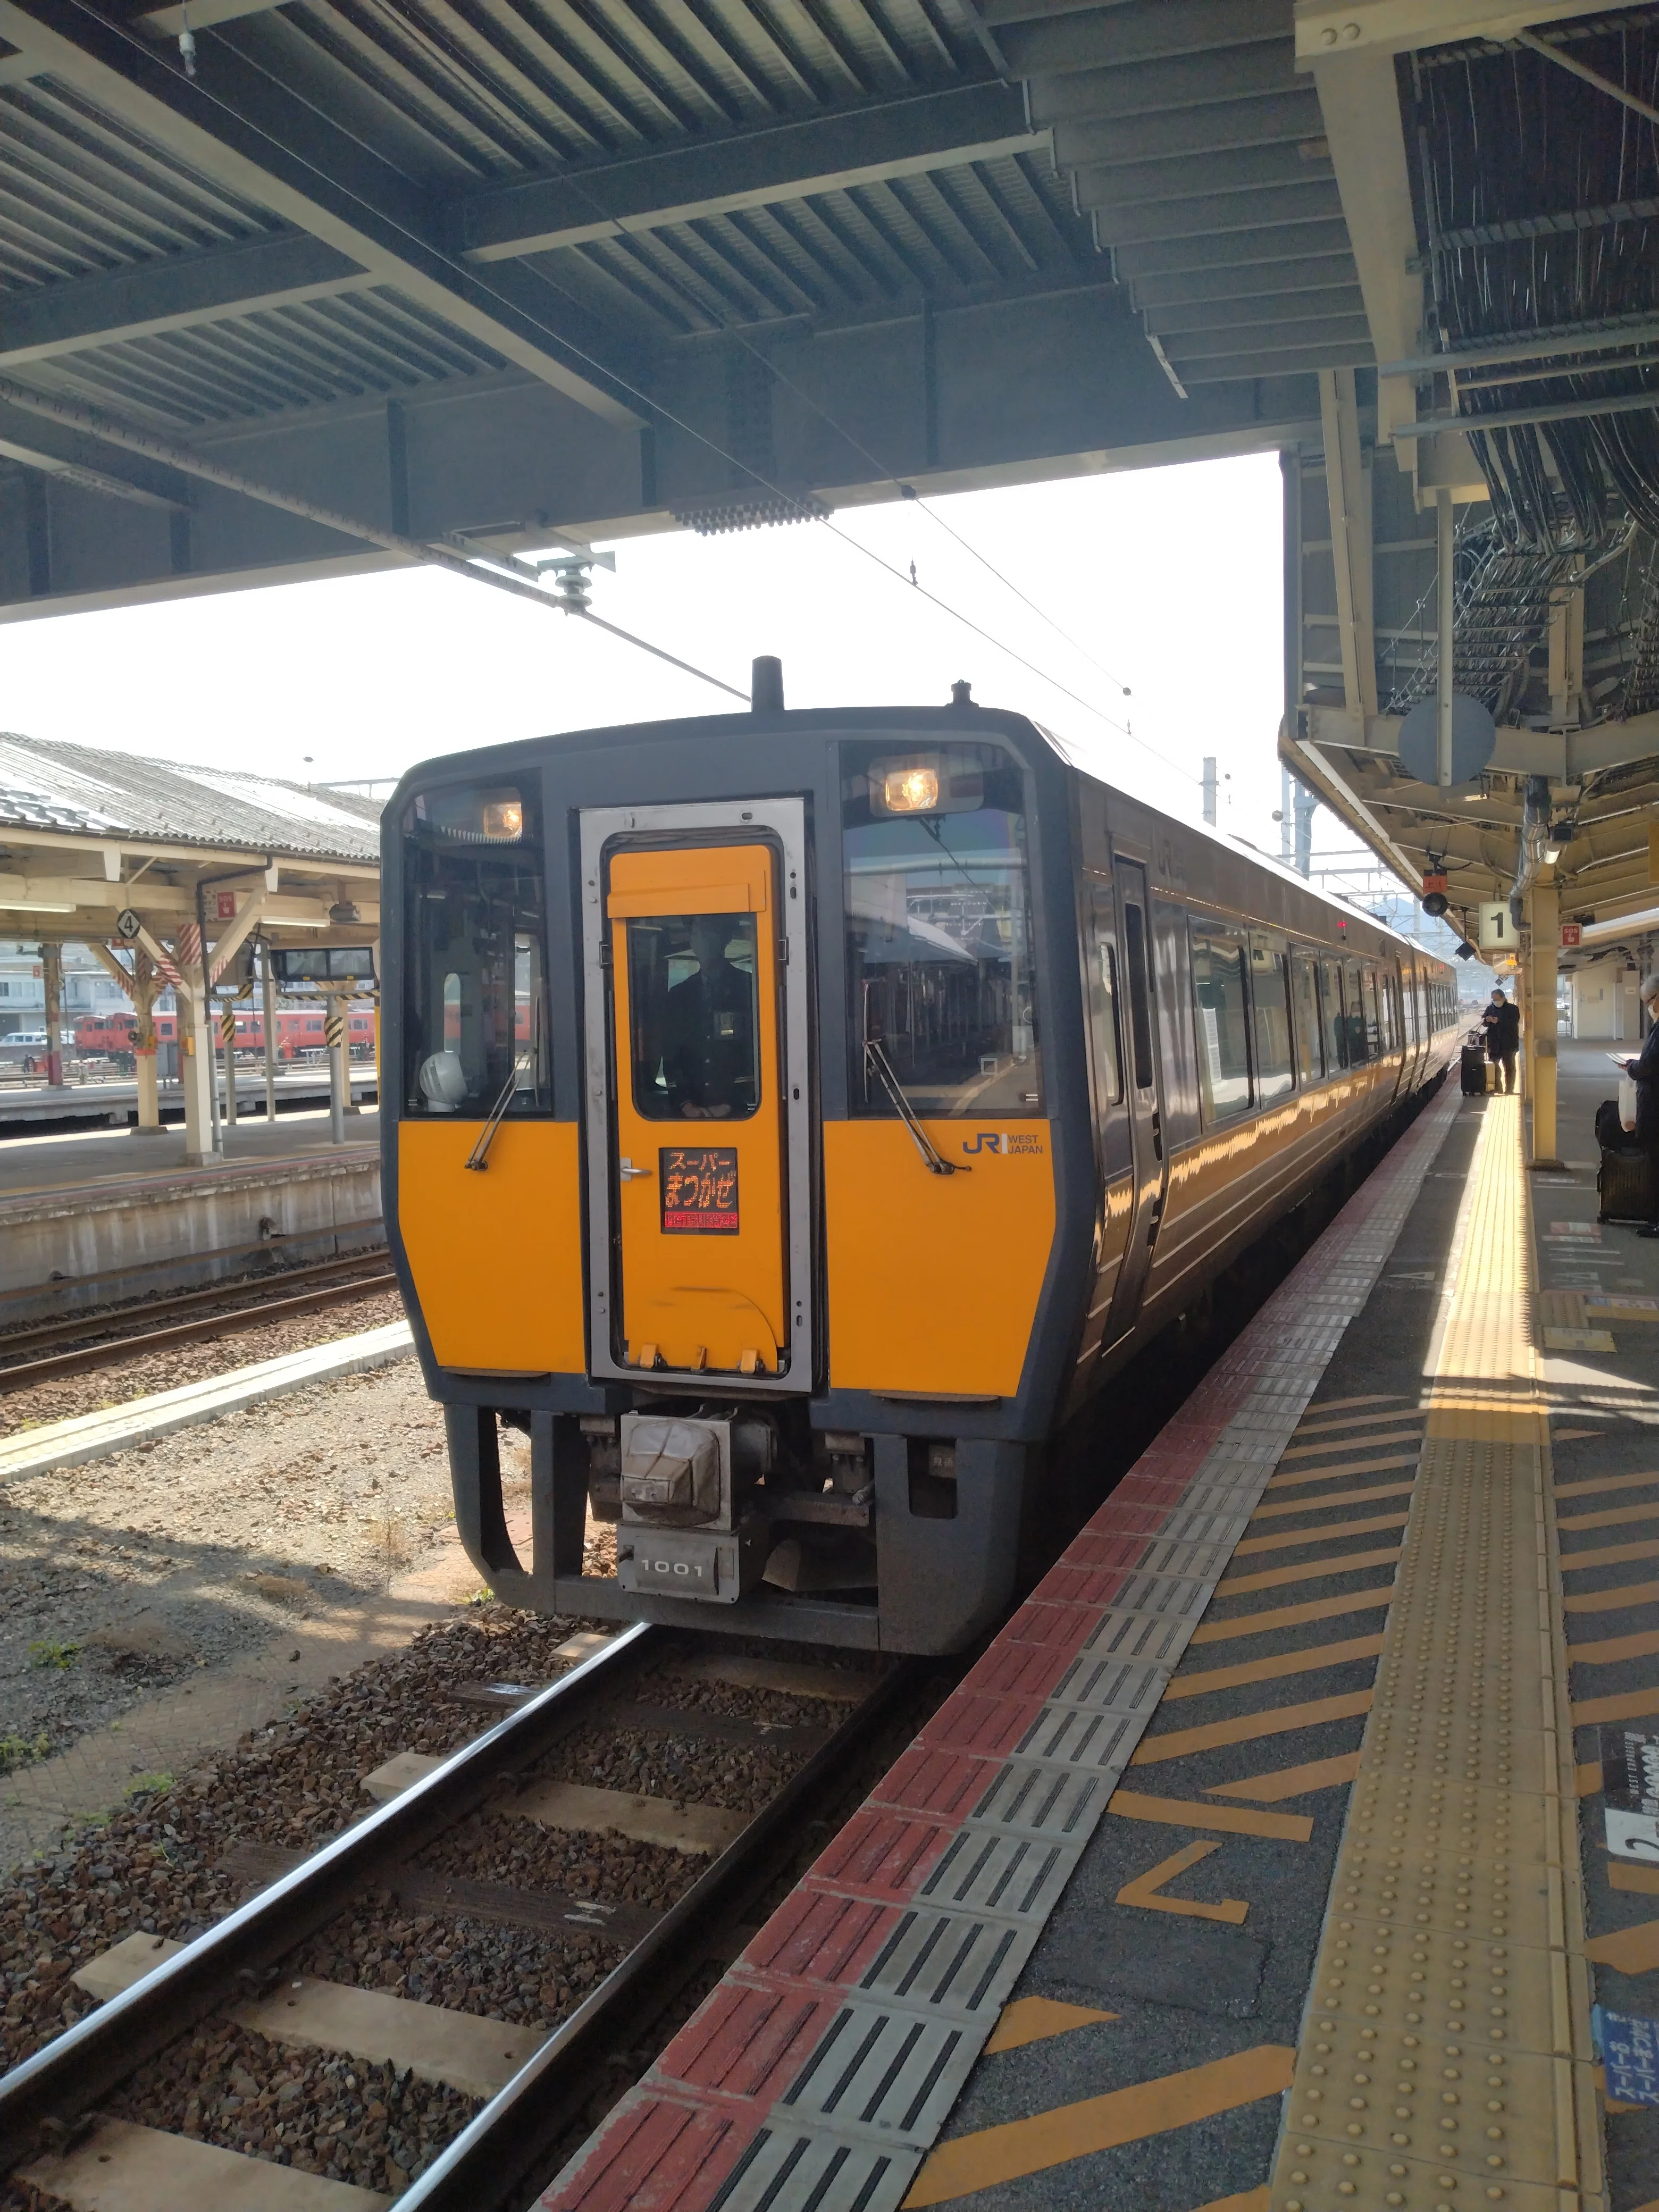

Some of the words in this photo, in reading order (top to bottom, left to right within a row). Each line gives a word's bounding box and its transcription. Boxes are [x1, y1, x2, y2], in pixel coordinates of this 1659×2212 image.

[124, 916, 133, 932] 4
[1490, 912, 1503, 938] 1
[962, 1133, 1000, 1154] JR
[1008, 1135, 1038, 1144] WEST
[1008, 1145, 1043, 1154] JAPAN
[669, 1153, 731, 1171] スーパー
[666, 1171, 736, 1208] まつかぜ
[641, 1560, 702, 1577] 1001
[1628, 1774, 1640, 1795] WEST
